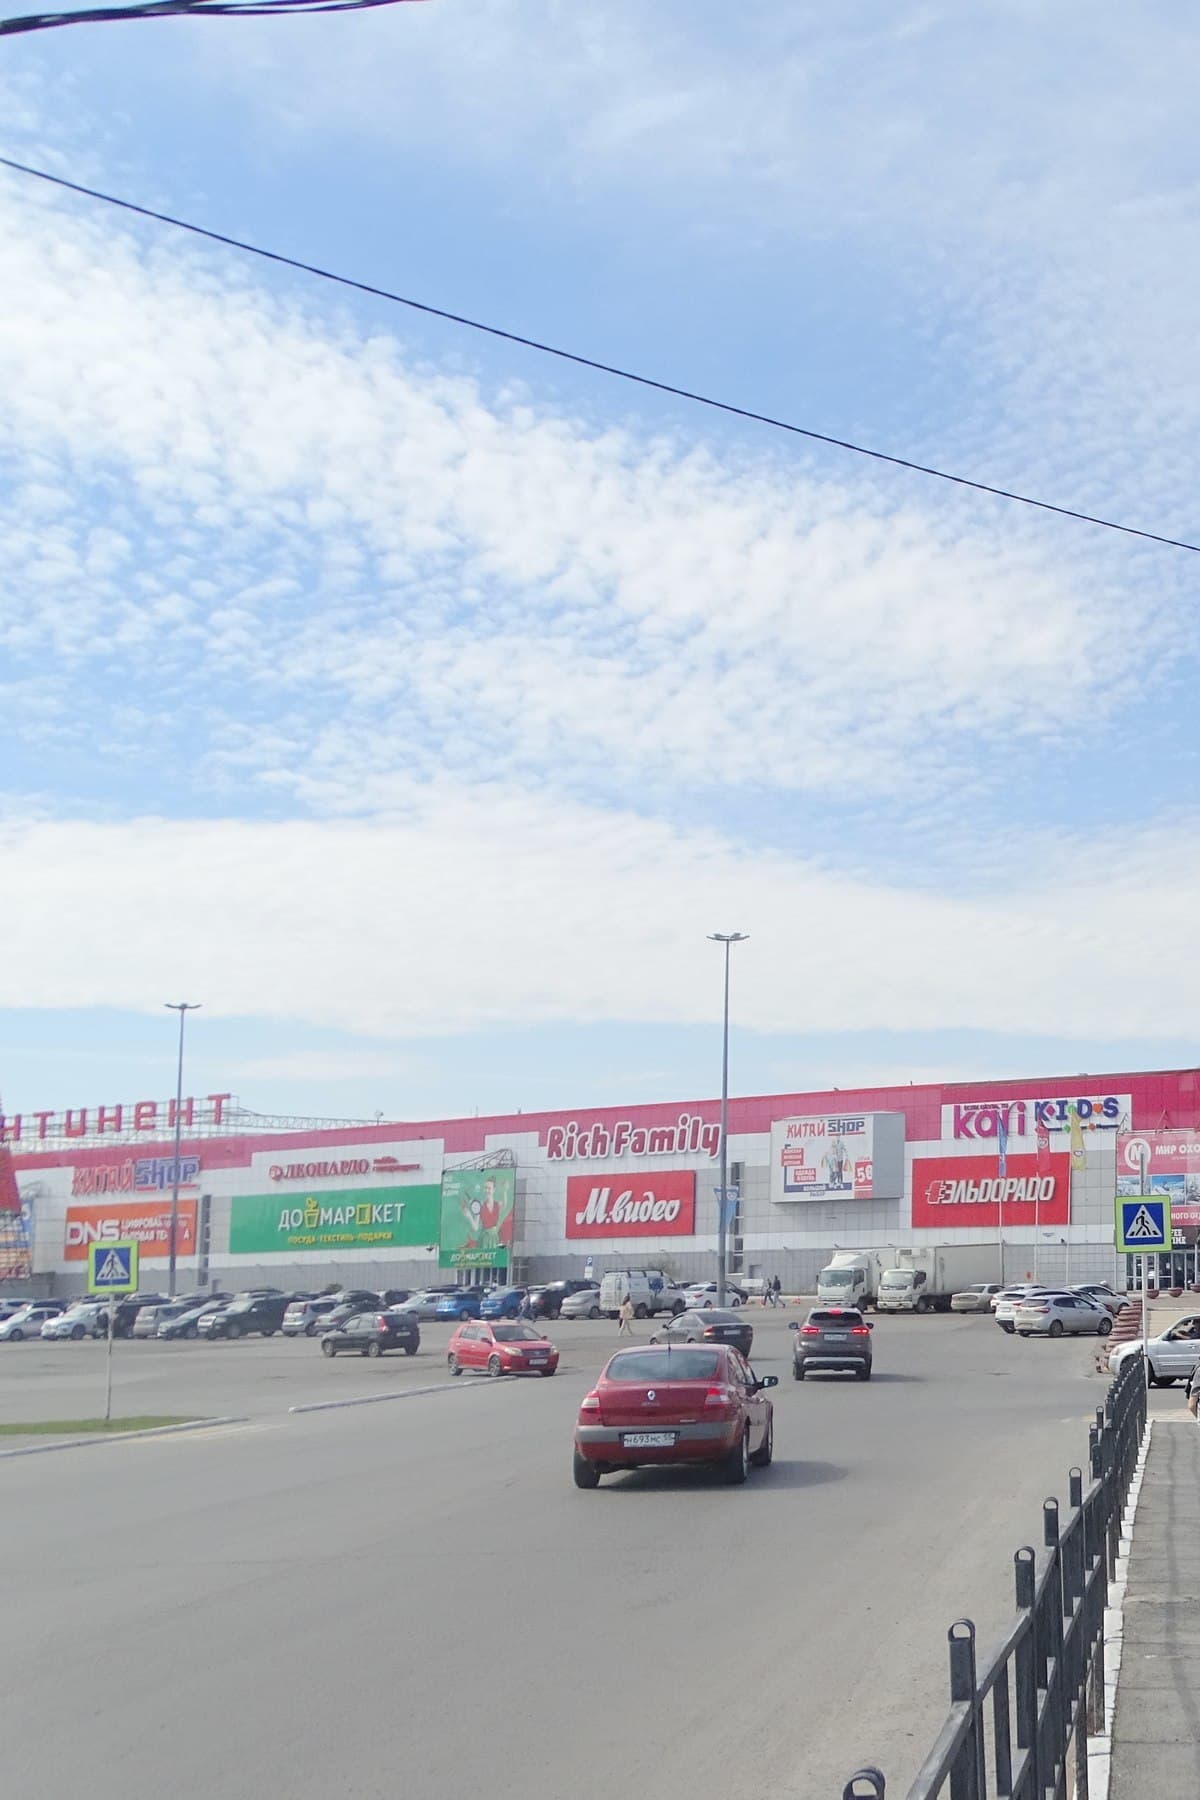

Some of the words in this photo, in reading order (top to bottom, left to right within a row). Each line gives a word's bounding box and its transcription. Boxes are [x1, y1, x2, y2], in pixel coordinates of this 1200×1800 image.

[787, 1120, 825, 1139] КИТАЙ
[828, 1118, 865, 1136] SHOP
[954, 1101, 1026, 1139] kari
[548, 1121, 610, 1160] Rich
[613, 1113, 722, 1160] Family
[1155, 1144, 1176, 1155] МИР
[72, 1159, 134, 1195] КИТАЙ
[67, 1219, 121, 1246] DNS
